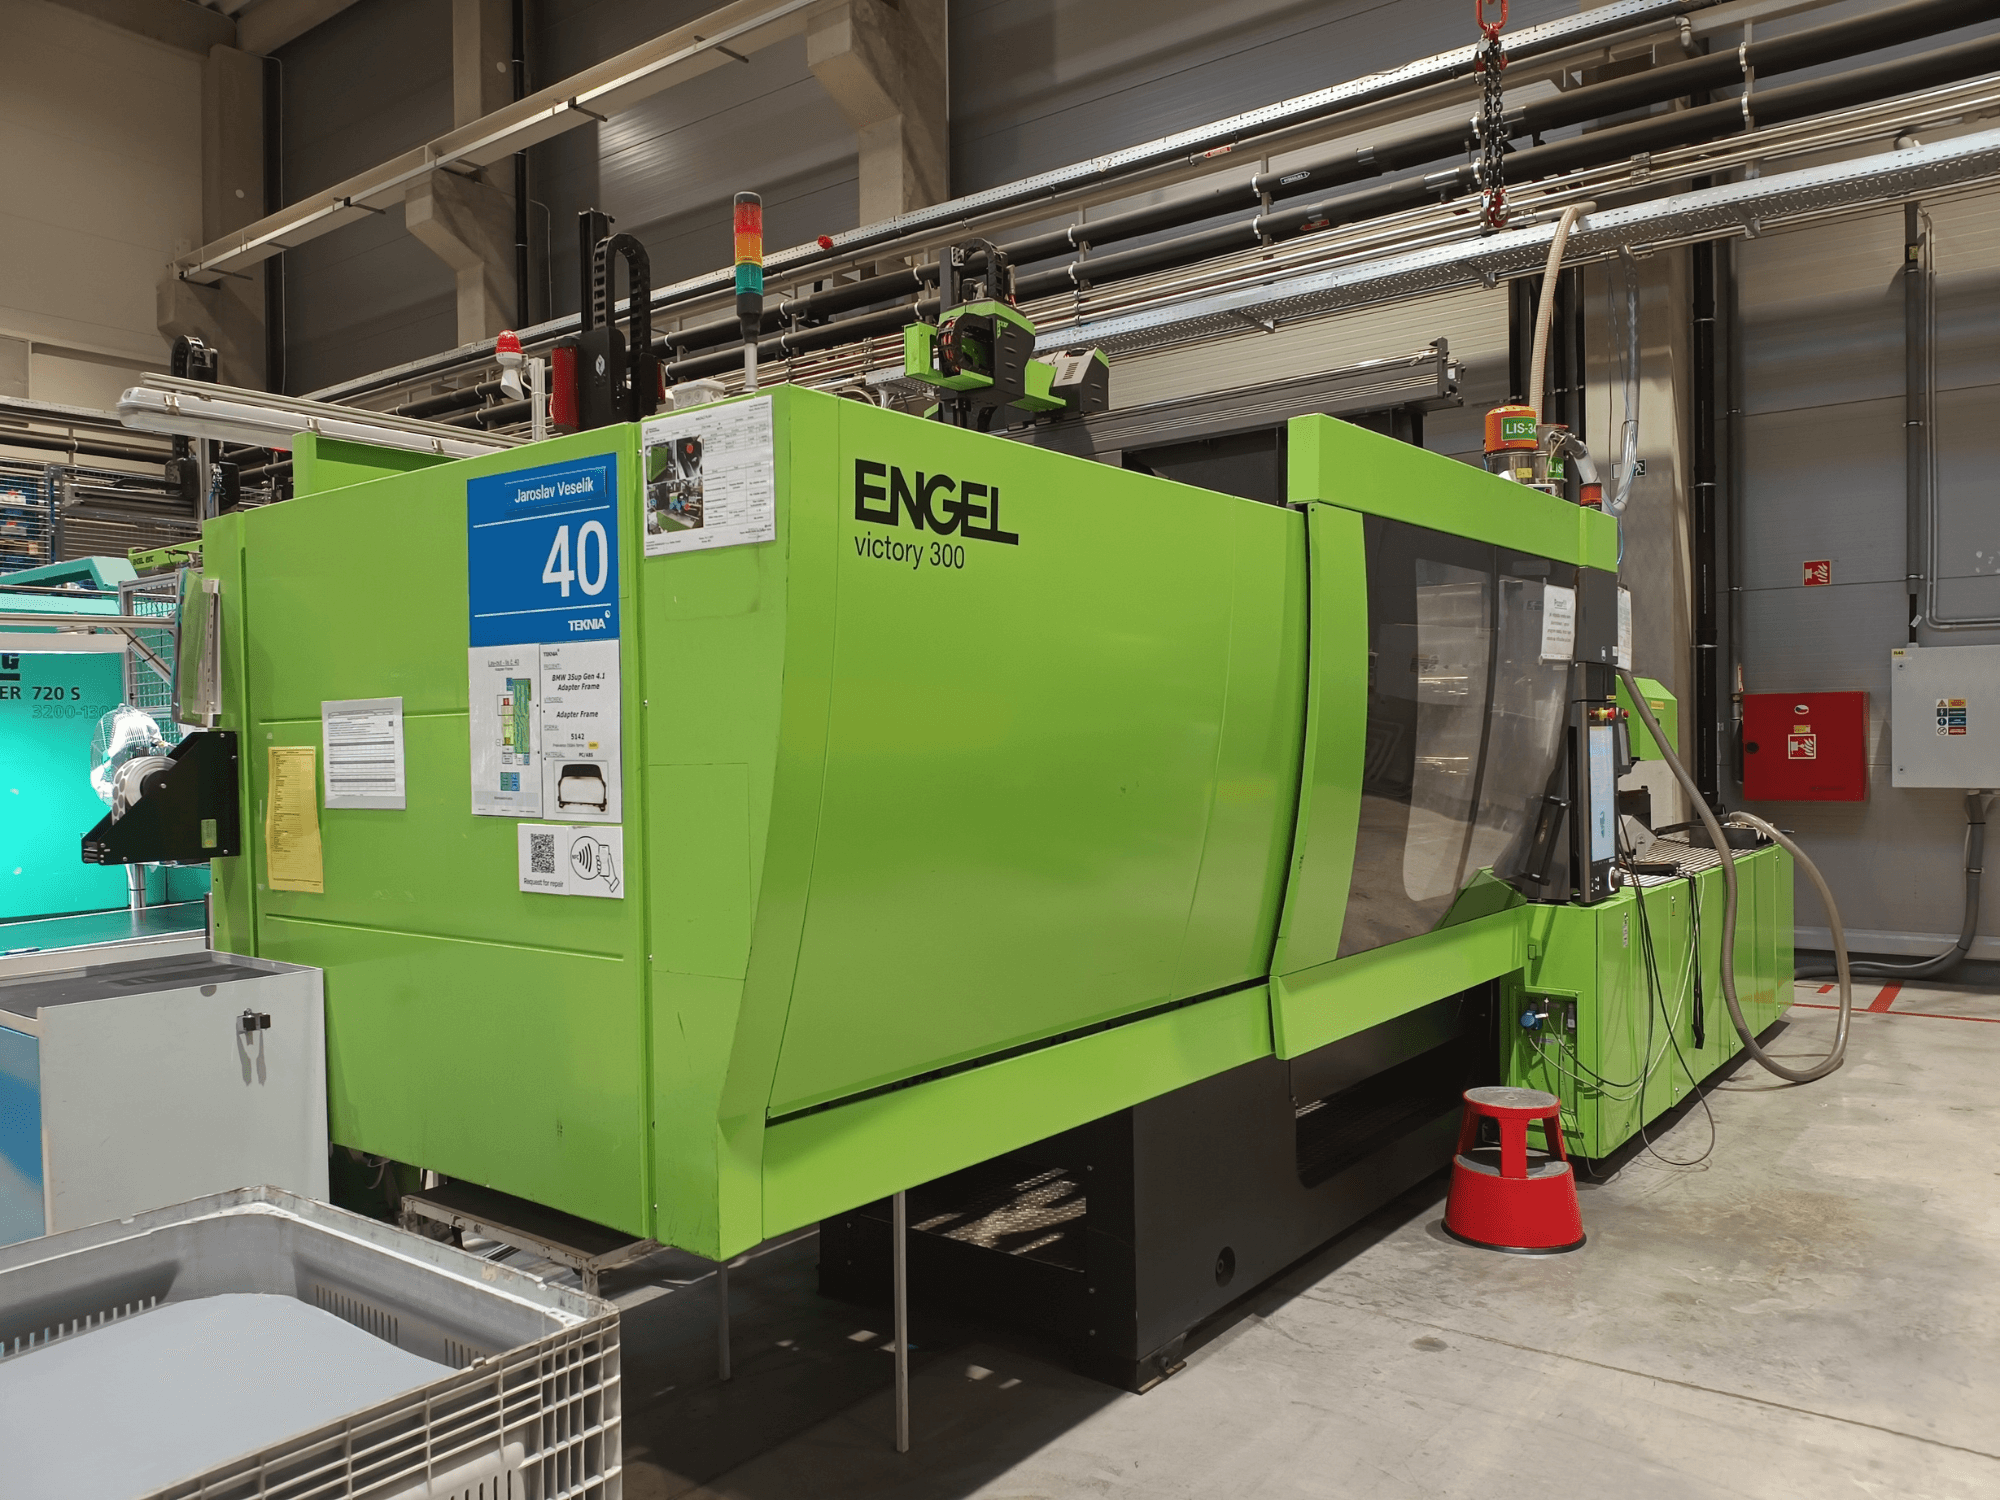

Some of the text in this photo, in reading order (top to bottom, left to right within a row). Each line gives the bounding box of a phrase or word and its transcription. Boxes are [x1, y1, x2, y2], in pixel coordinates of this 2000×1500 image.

[514, 476, 594, 503] Jaroslav Veselík
[855, 458, 1019, 545] ENGEL
[854, 531, 965, 570] victory 300
[542, 520, 609, 598] 40
[567, 617, 606, 632] TEKNIA
[583, 672, 595, 680] Gen
[32, 686, 65, 701] 720
[70, 686, 81, 701] S
[557, 683, 600, 692] Adapter Frame
[556, 710, 599, 720] Adapter Frame
[523, 877, 542, 887] Request
[550, 880, 564, 889] repair
